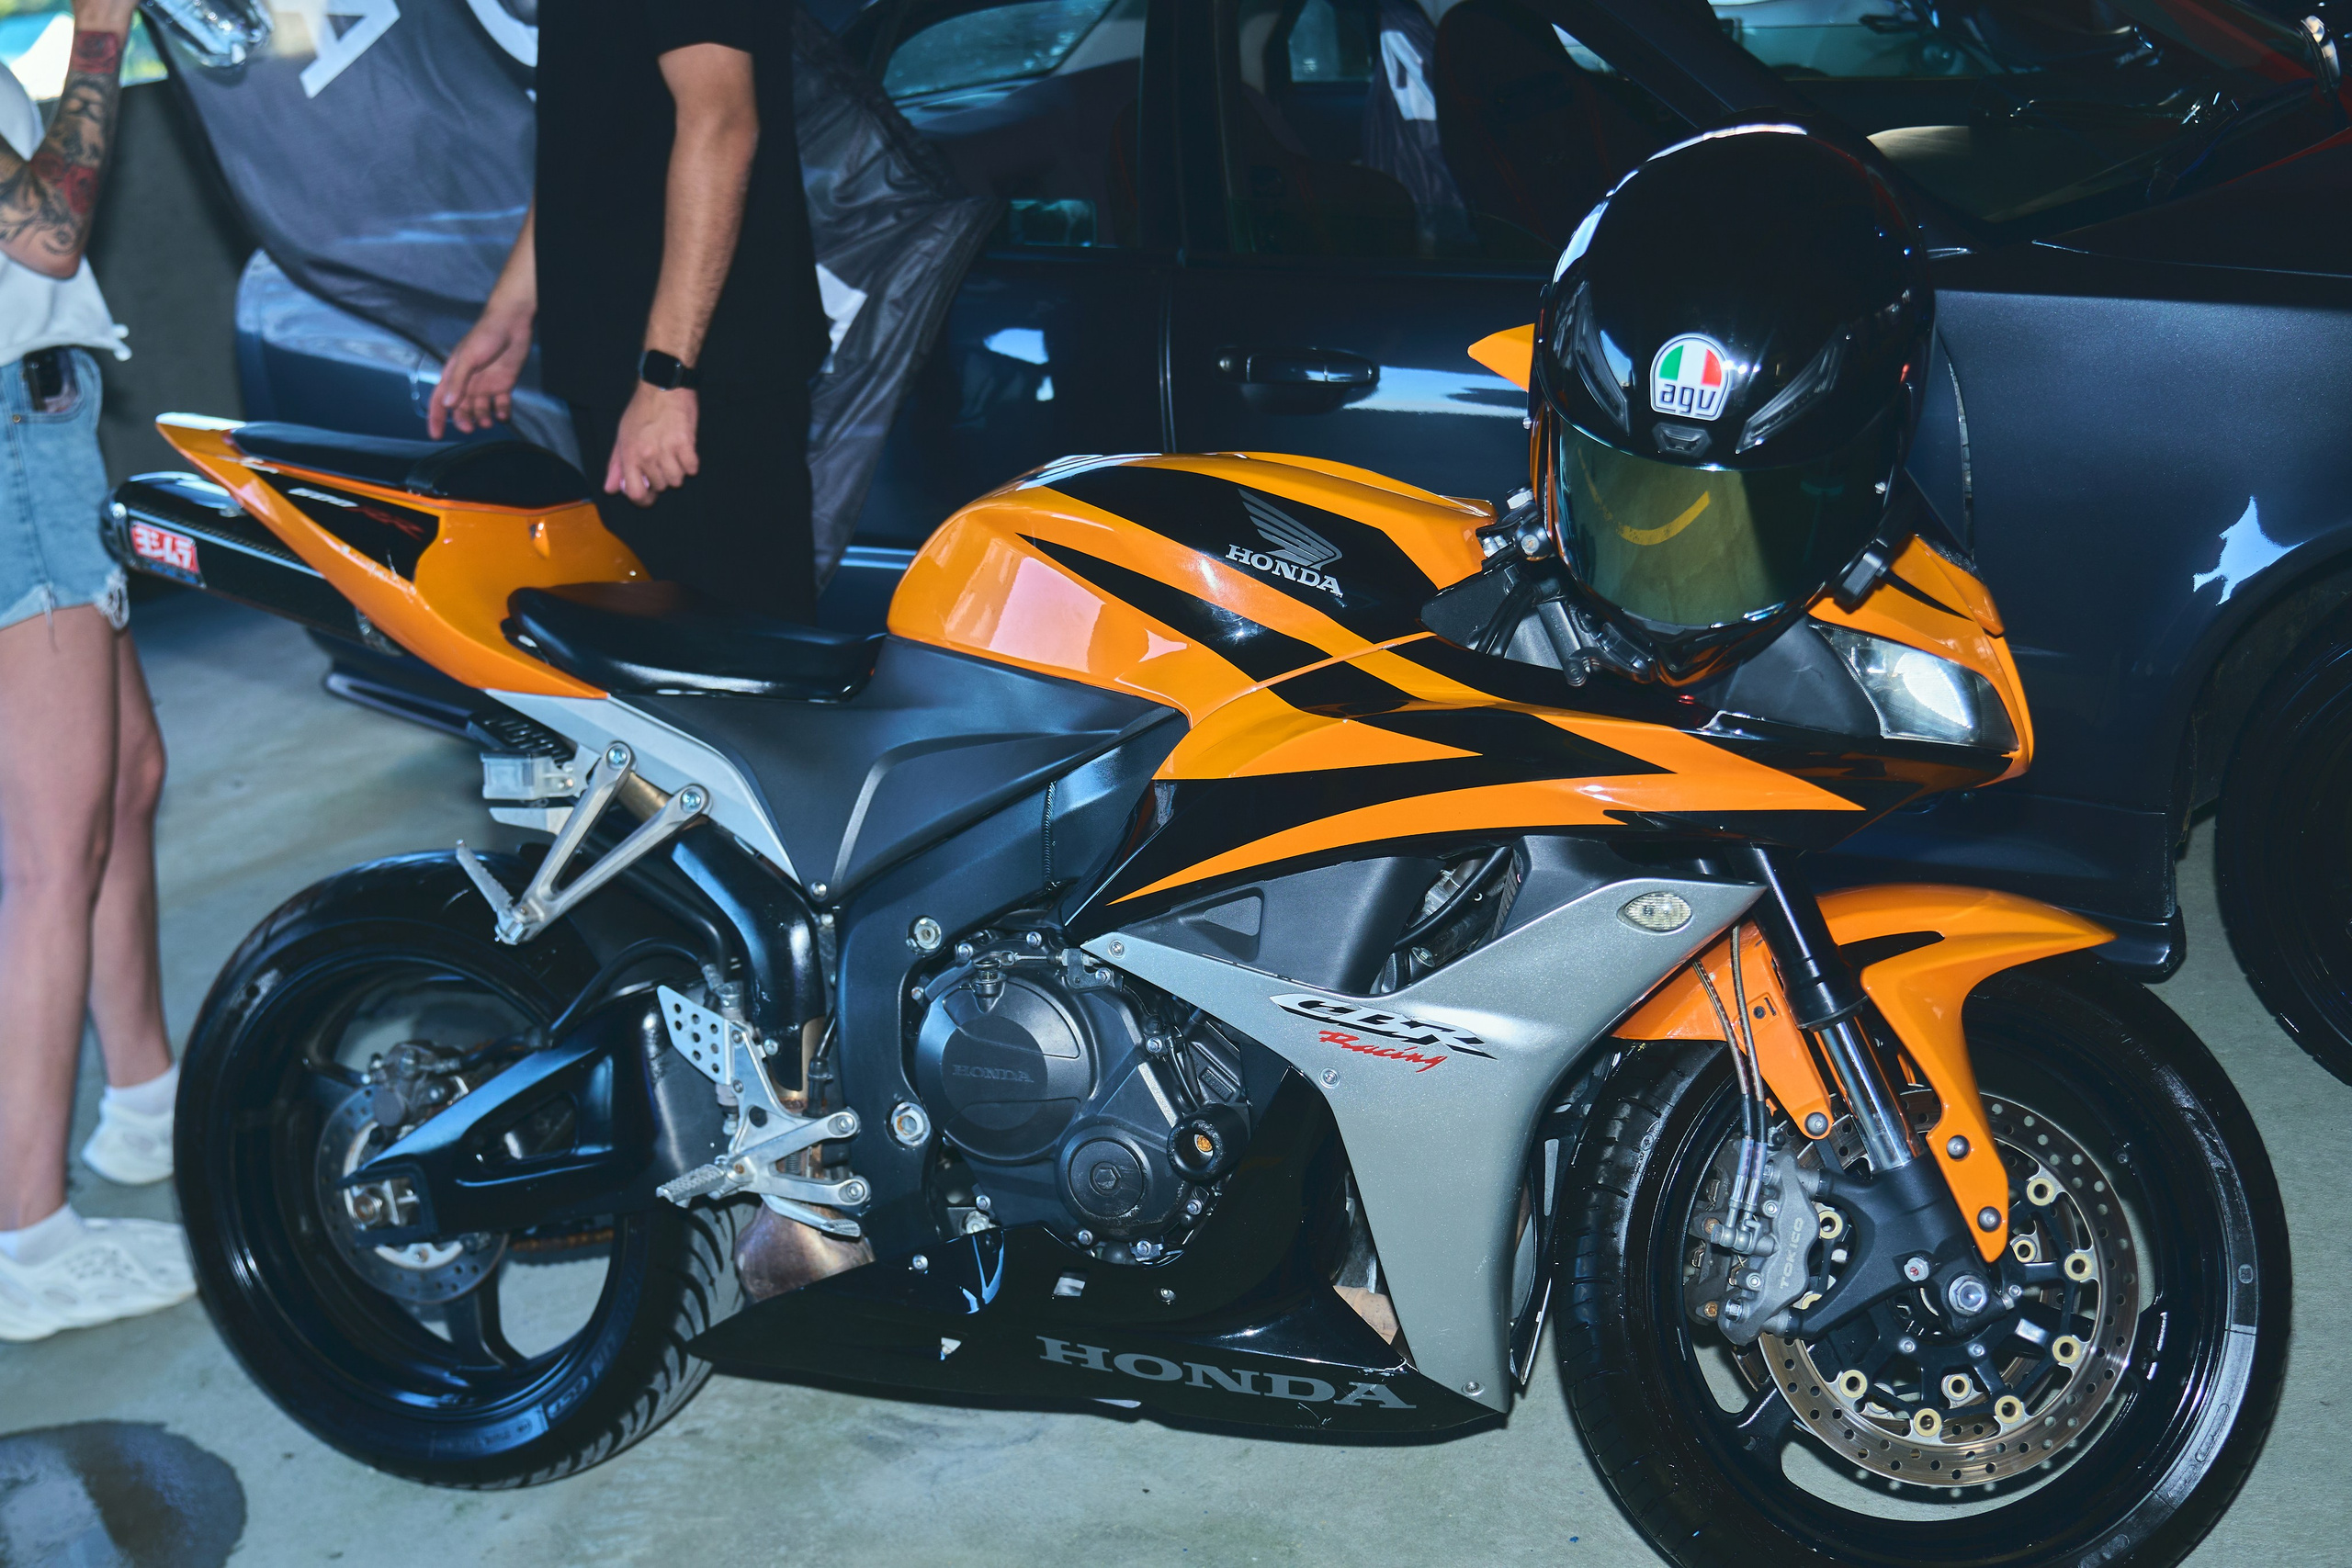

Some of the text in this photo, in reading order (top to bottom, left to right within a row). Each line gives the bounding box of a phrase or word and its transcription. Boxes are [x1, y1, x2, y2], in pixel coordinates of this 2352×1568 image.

[1660, 383, 1716, 413] agv
[135, 526, 192, 569] ヨシムラ
[1225, 544, 1343, 598] HONDA
[1269, 993, 1498, 1060] CBR
[952, 1065, 1035, 1083] HONDA
[1318, 1030, 1448, 1073] Racing
[1780, 1217, 1804, 1290] TOKICO
[1035, 1336, 1417, 1409] HONDA
